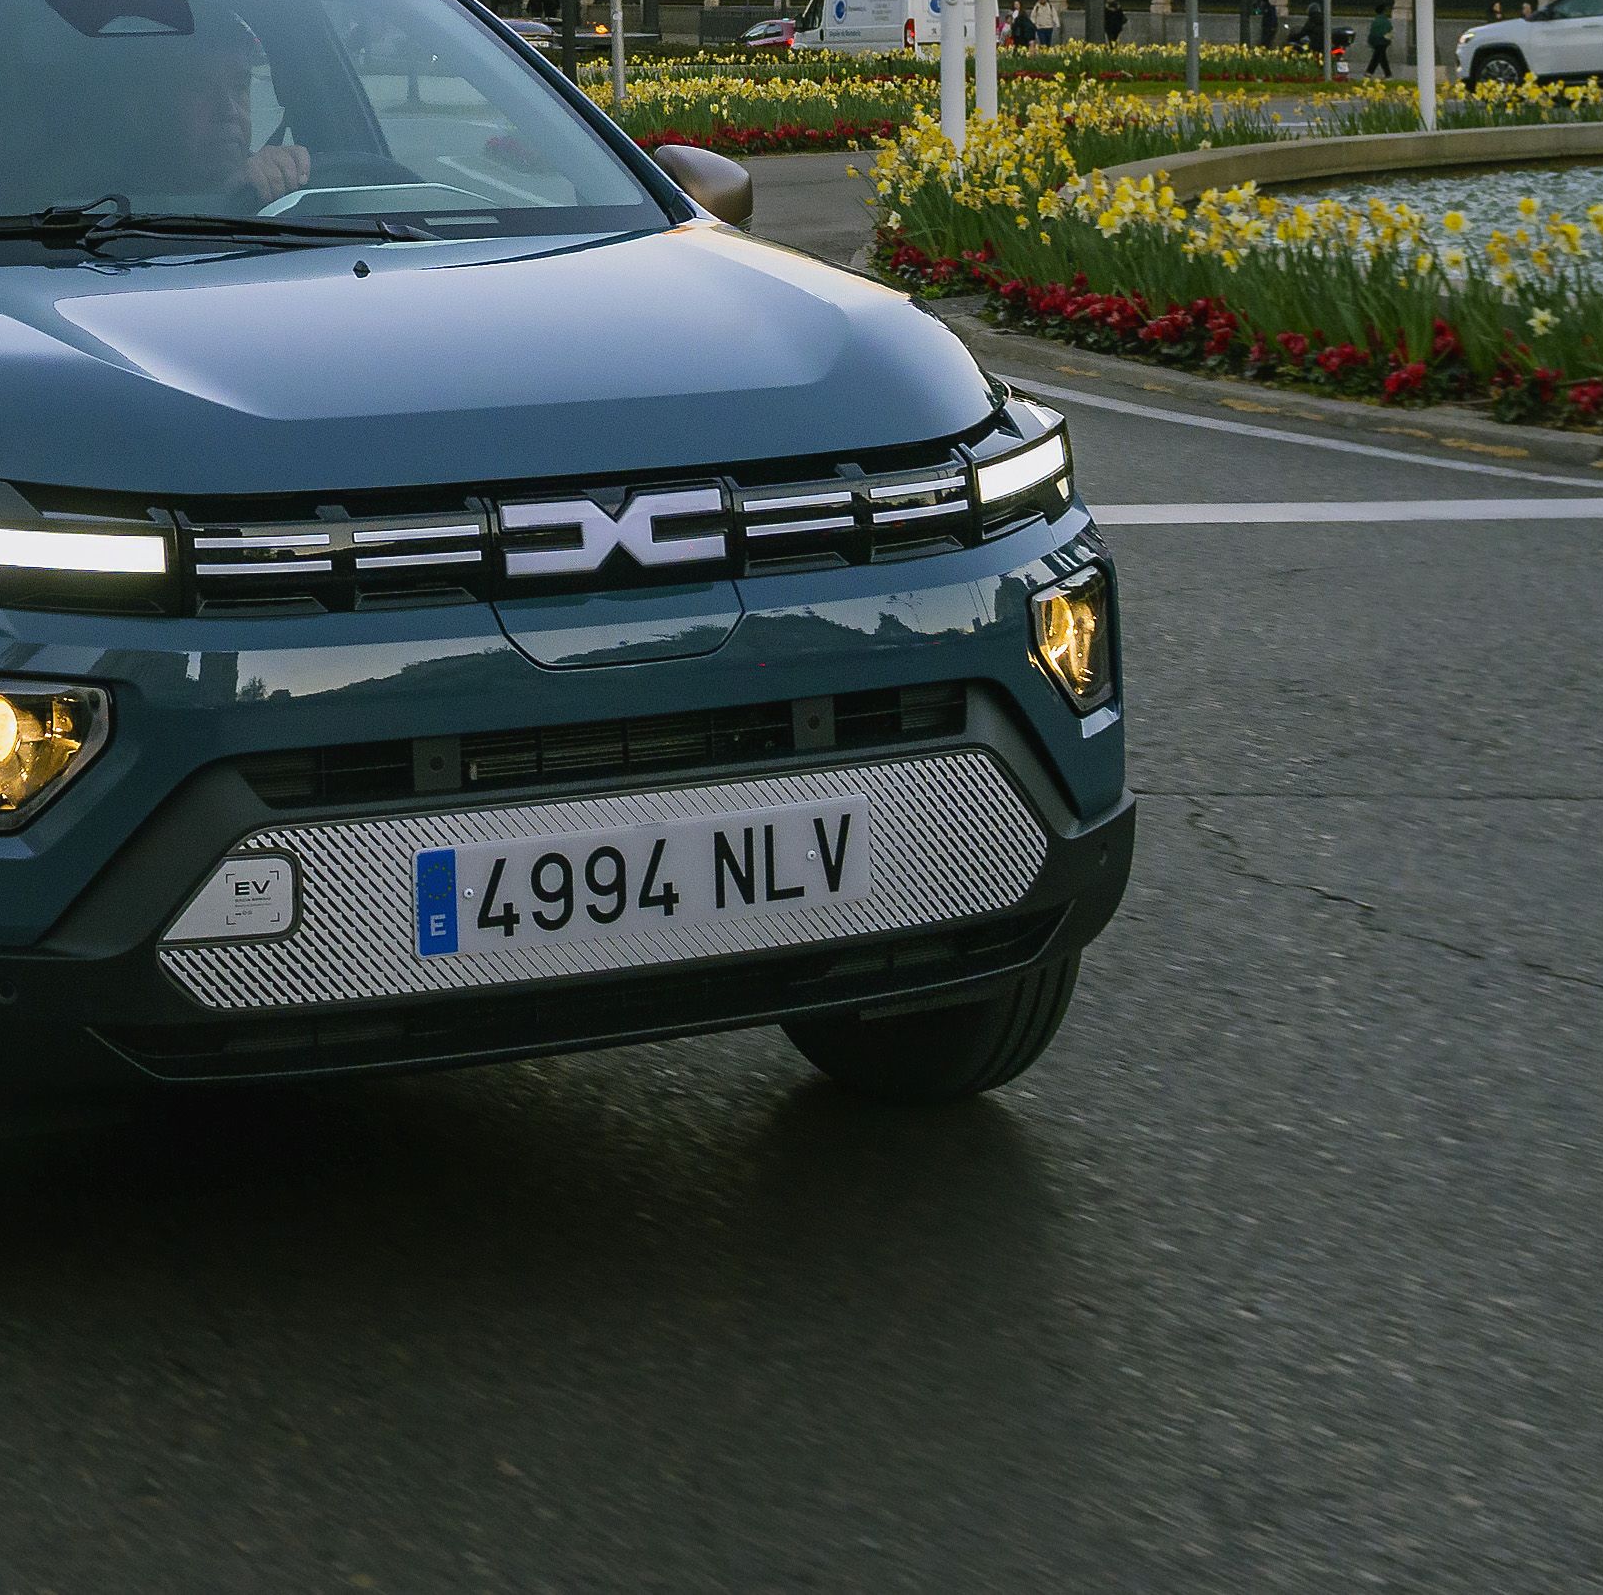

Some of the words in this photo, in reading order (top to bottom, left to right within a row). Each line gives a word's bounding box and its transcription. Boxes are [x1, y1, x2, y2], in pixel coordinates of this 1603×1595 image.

[477, 839, 679, 937] 4994
[713, 813, 852, 909] NLV
[235, 880, 270, 896] EV
[430, 914, 447, 937] E
